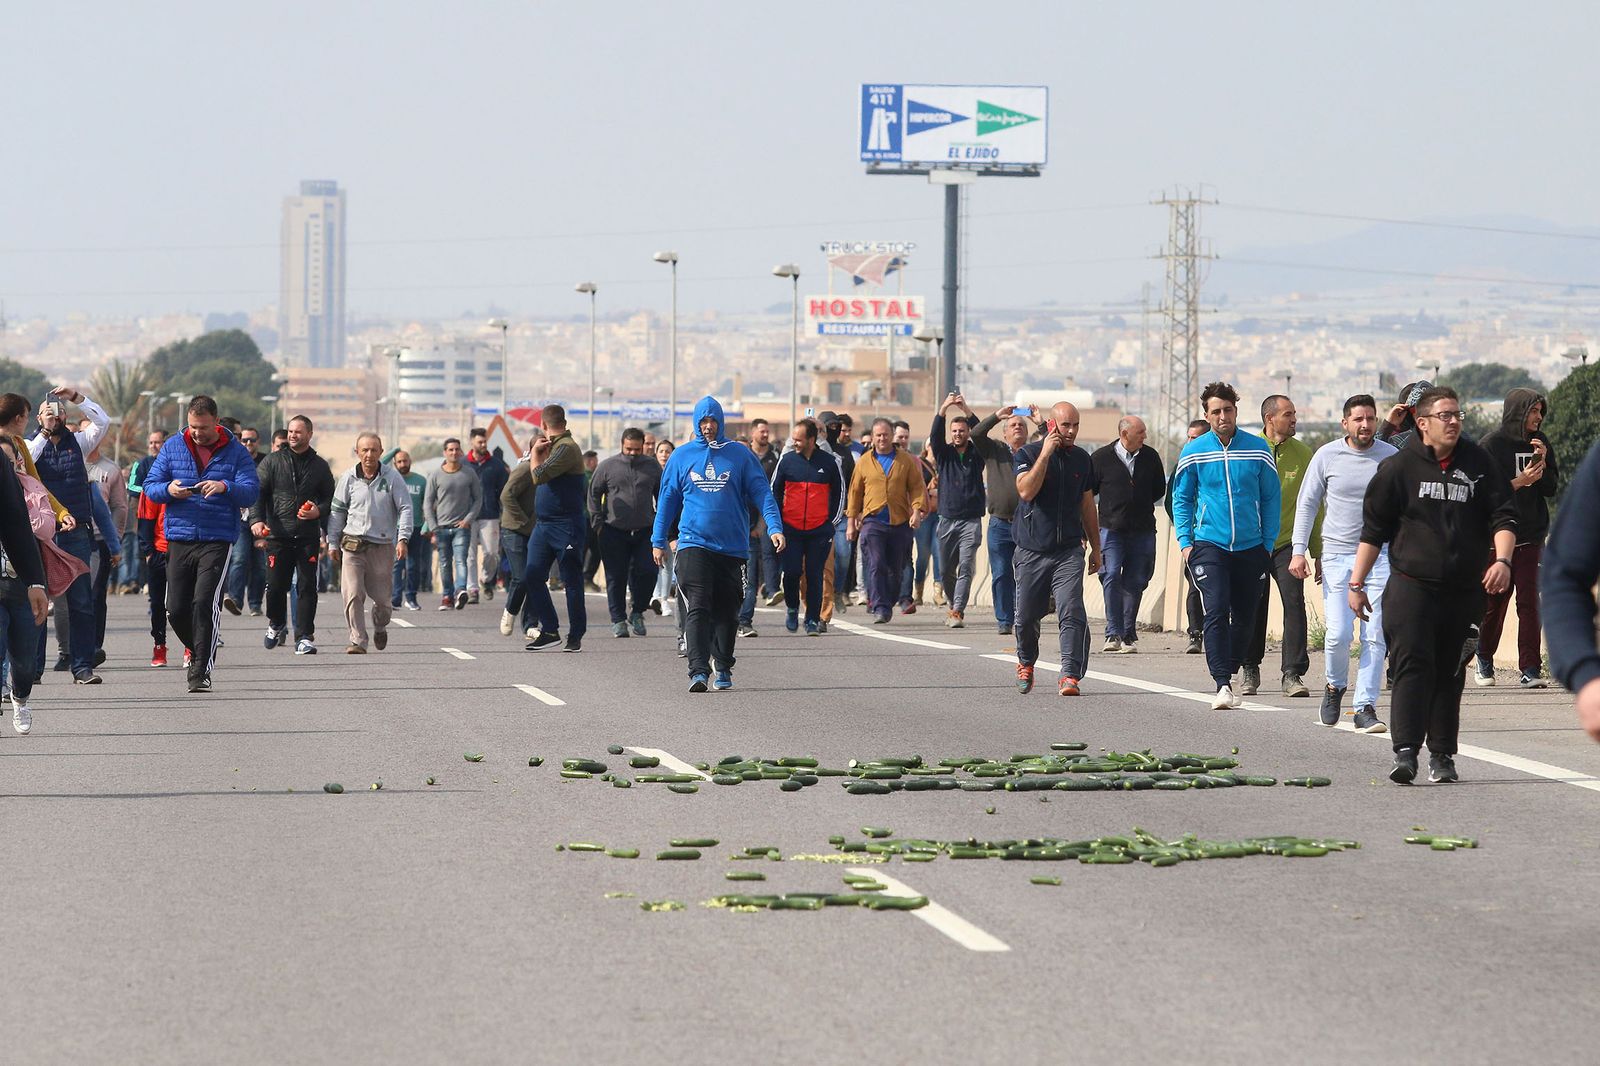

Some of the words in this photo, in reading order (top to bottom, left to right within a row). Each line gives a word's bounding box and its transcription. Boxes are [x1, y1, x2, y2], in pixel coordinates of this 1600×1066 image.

[870, 95, 893, 106] 411
[948, 147, 959, 158] EL
[966, 147, 999, 159] EJIDO
[826, 241, 873, 254] TRUCK
[876, 242, 916, 254] STOP
[810, 300, 921, 318] HOSTAL
[1419, 481, 1469, 503] PUMA
